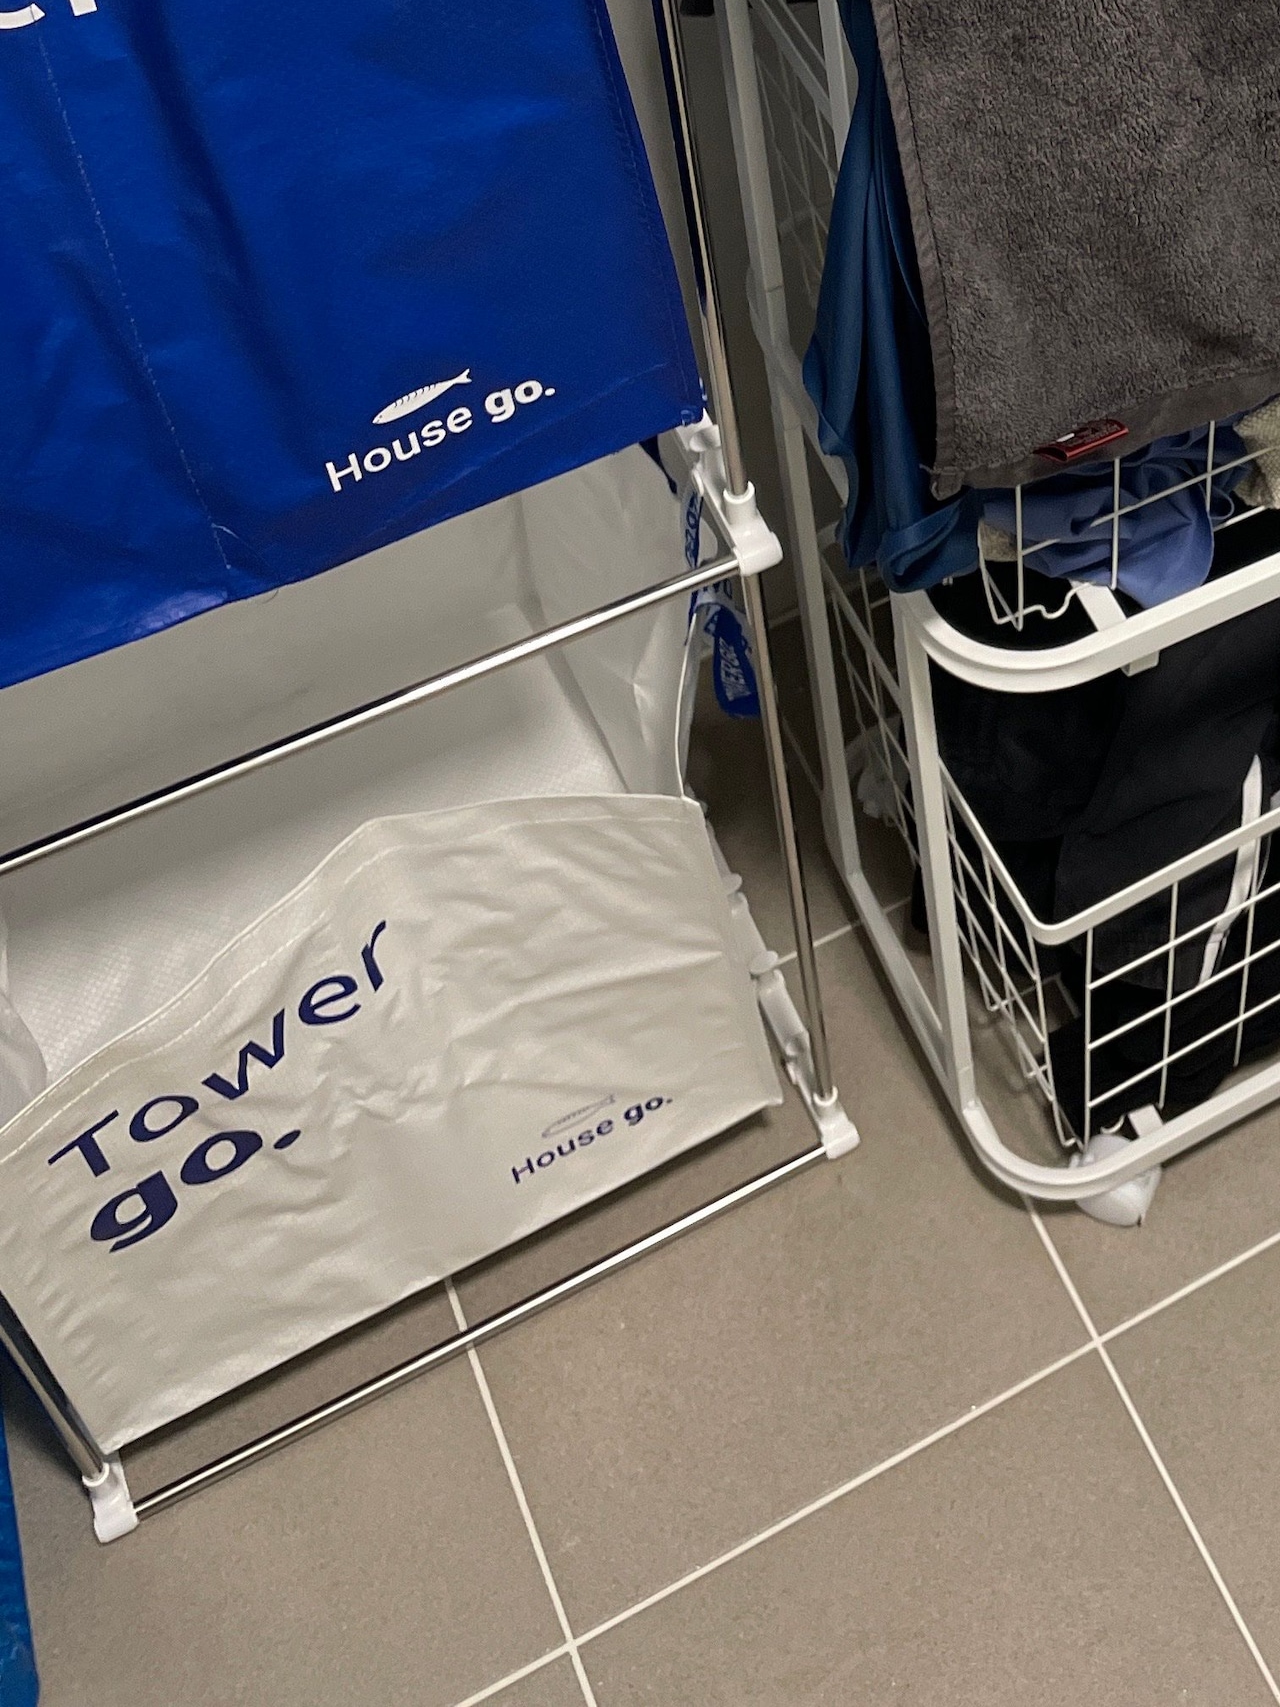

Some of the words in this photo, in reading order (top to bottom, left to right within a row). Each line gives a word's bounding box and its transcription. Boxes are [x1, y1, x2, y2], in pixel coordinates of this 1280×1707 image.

[325, 406, 473, 493] House
[484, 379, 556, 424] go.
[47, 919, 388, 1178] Tower
[90, 1128, 302, 1253] go.
[511, 1118, 614, 1185] House
[623, 1095, 674, 1127] go.
